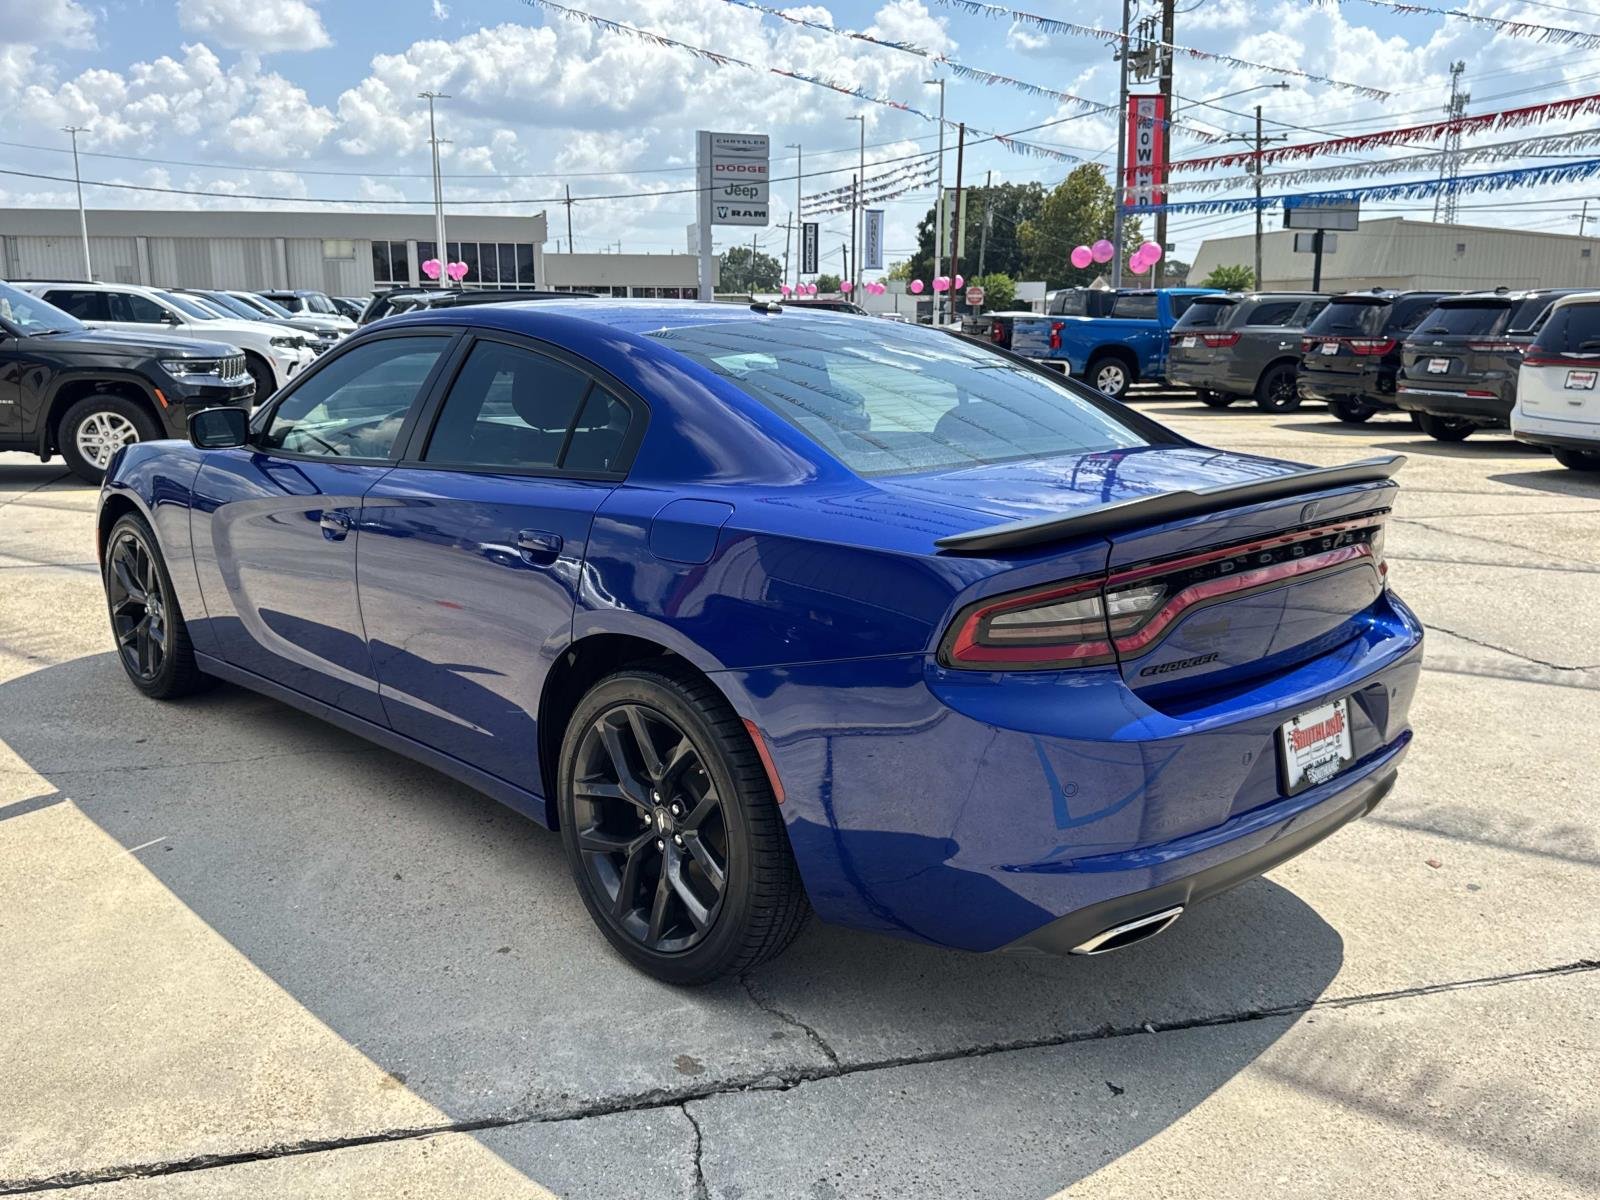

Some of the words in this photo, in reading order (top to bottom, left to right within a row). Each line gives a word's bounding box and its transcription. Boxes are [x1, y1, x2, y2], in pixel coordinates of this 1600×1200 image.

[715, 164, 767, 173] DODGE
[724, 182, 759, 199] Jeep
[731, 209, 767, 218] RAM
[1220, 534, 1354, 573] DODGE
[1292, 710, 1342, 752] SOUTHLAND
